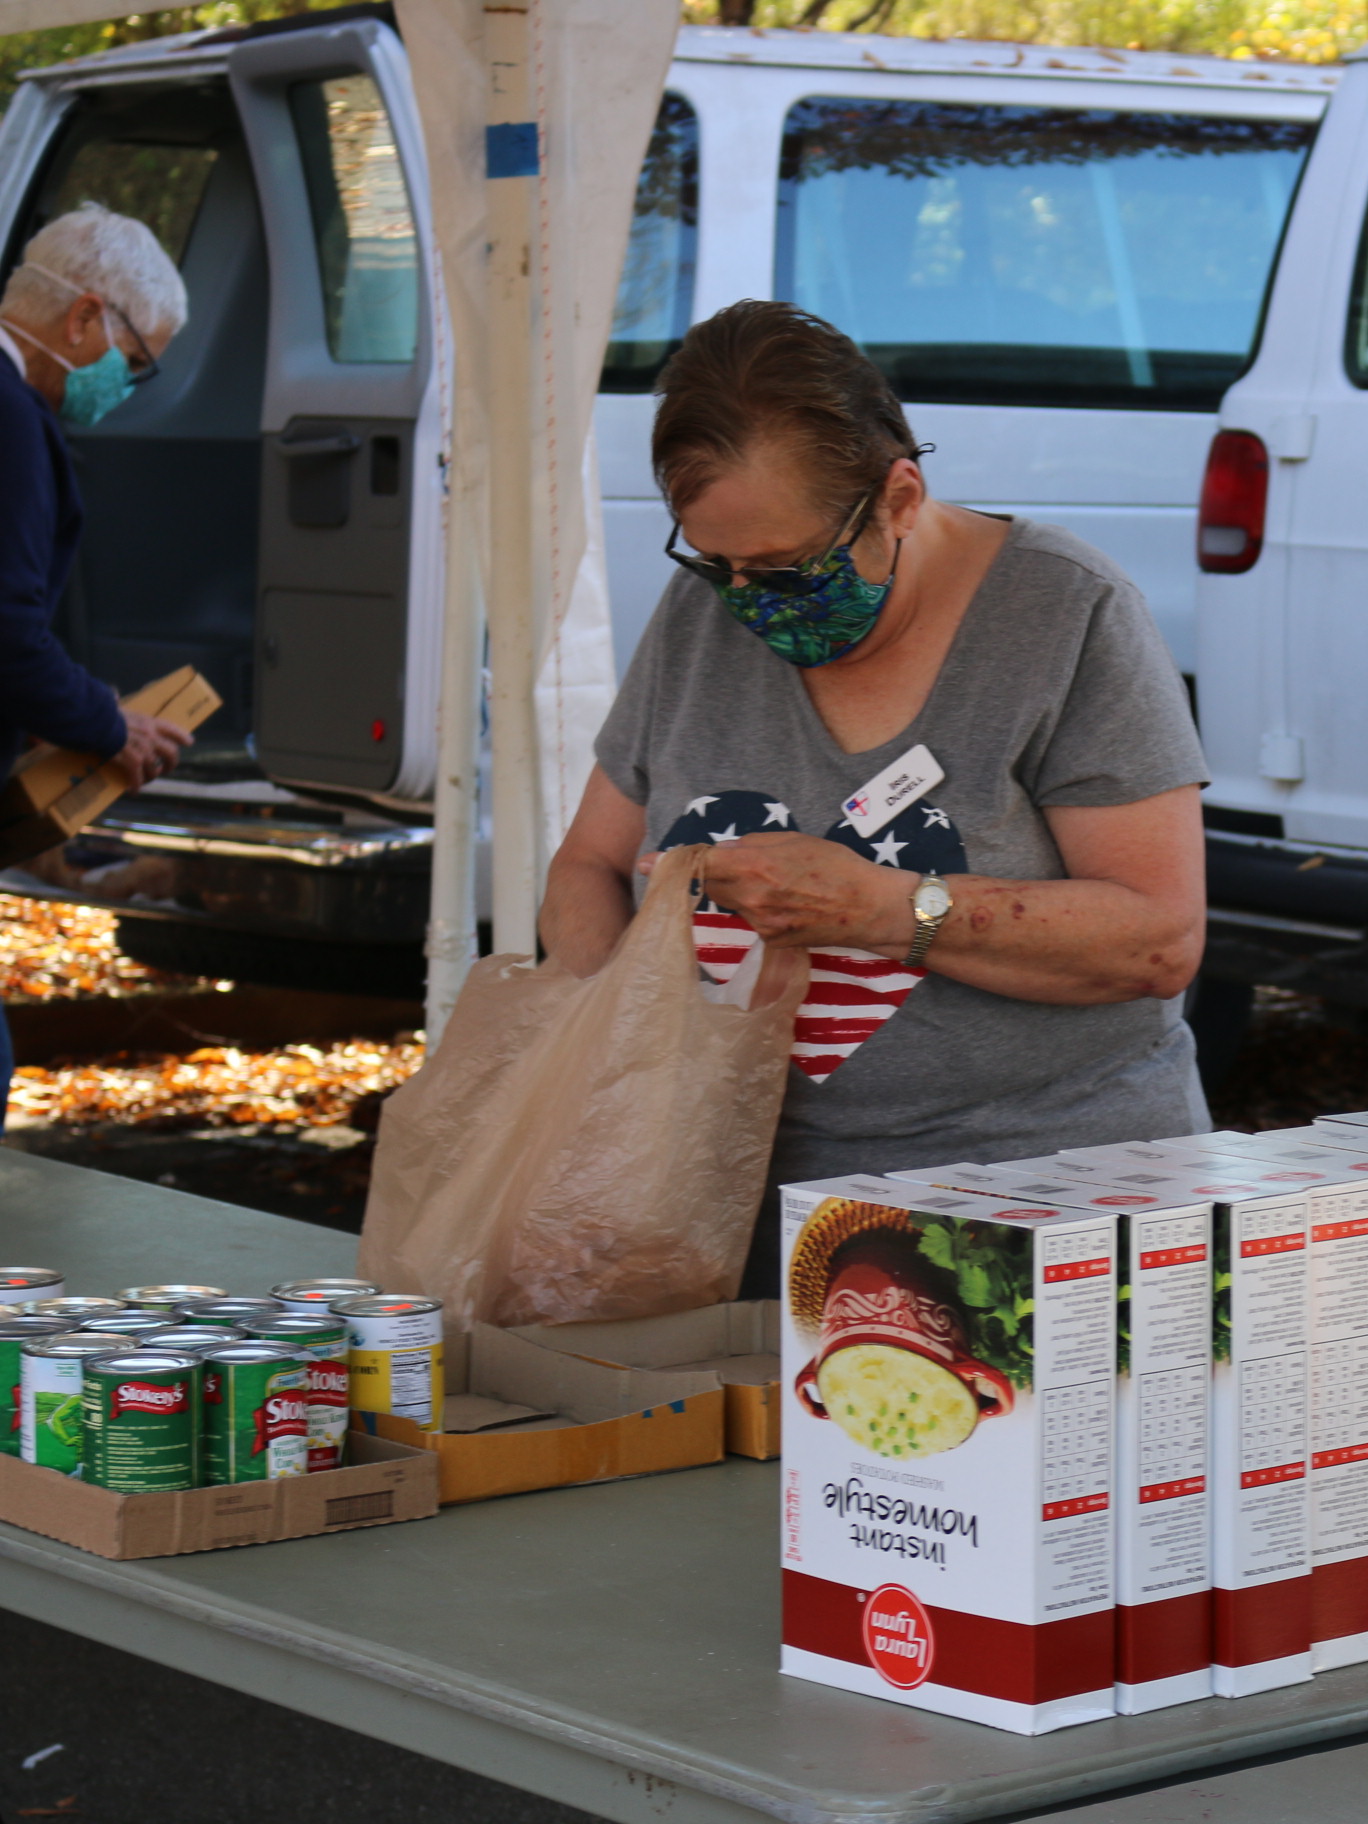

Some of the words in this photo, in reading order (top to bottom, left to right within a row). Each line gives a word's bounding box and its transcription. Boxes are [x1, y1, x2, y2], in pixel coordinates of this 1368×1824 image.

[822, 1477, 979, 1548] homestyle
[849, 1523, 946, 1571] instant
[871, 1611, 917, 1641] Lynn
[874, 1635, 927, 1668] Laura
